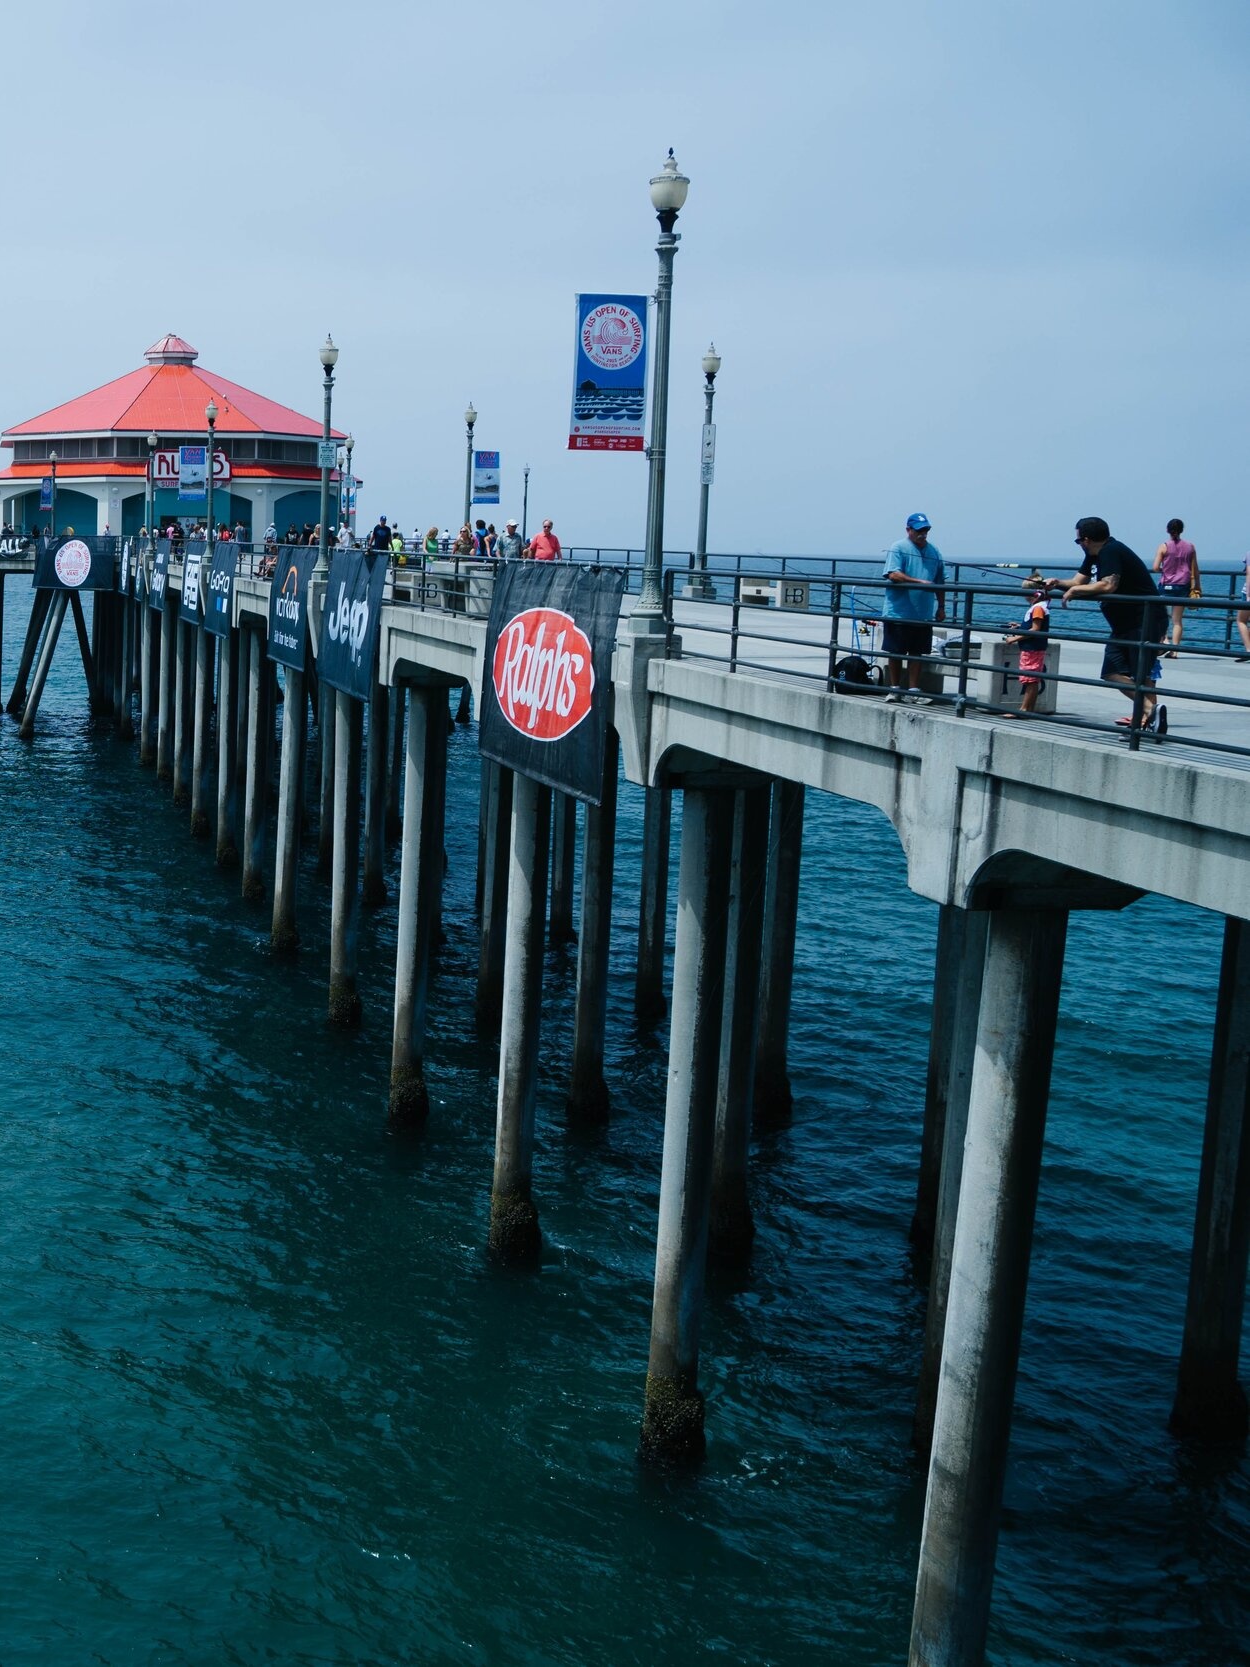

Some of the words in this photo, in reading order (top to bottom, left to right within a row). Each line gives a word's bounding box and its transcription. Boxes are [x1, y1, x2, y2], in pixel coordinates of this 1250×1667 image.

[595, 306, 617, 317] OPEN
[619, 308, 630, 318] OF
[586, 316, 596, 327] US
[584, 330, 593, 353] VANS
[629, 317, 642, 354] SURFING
[601, 346, 622, 355] VANS
[785, 588, 805, 603] HB
[329, 582, 369, 662] Jeep
[500, 621, 584, 729] Ralphs
